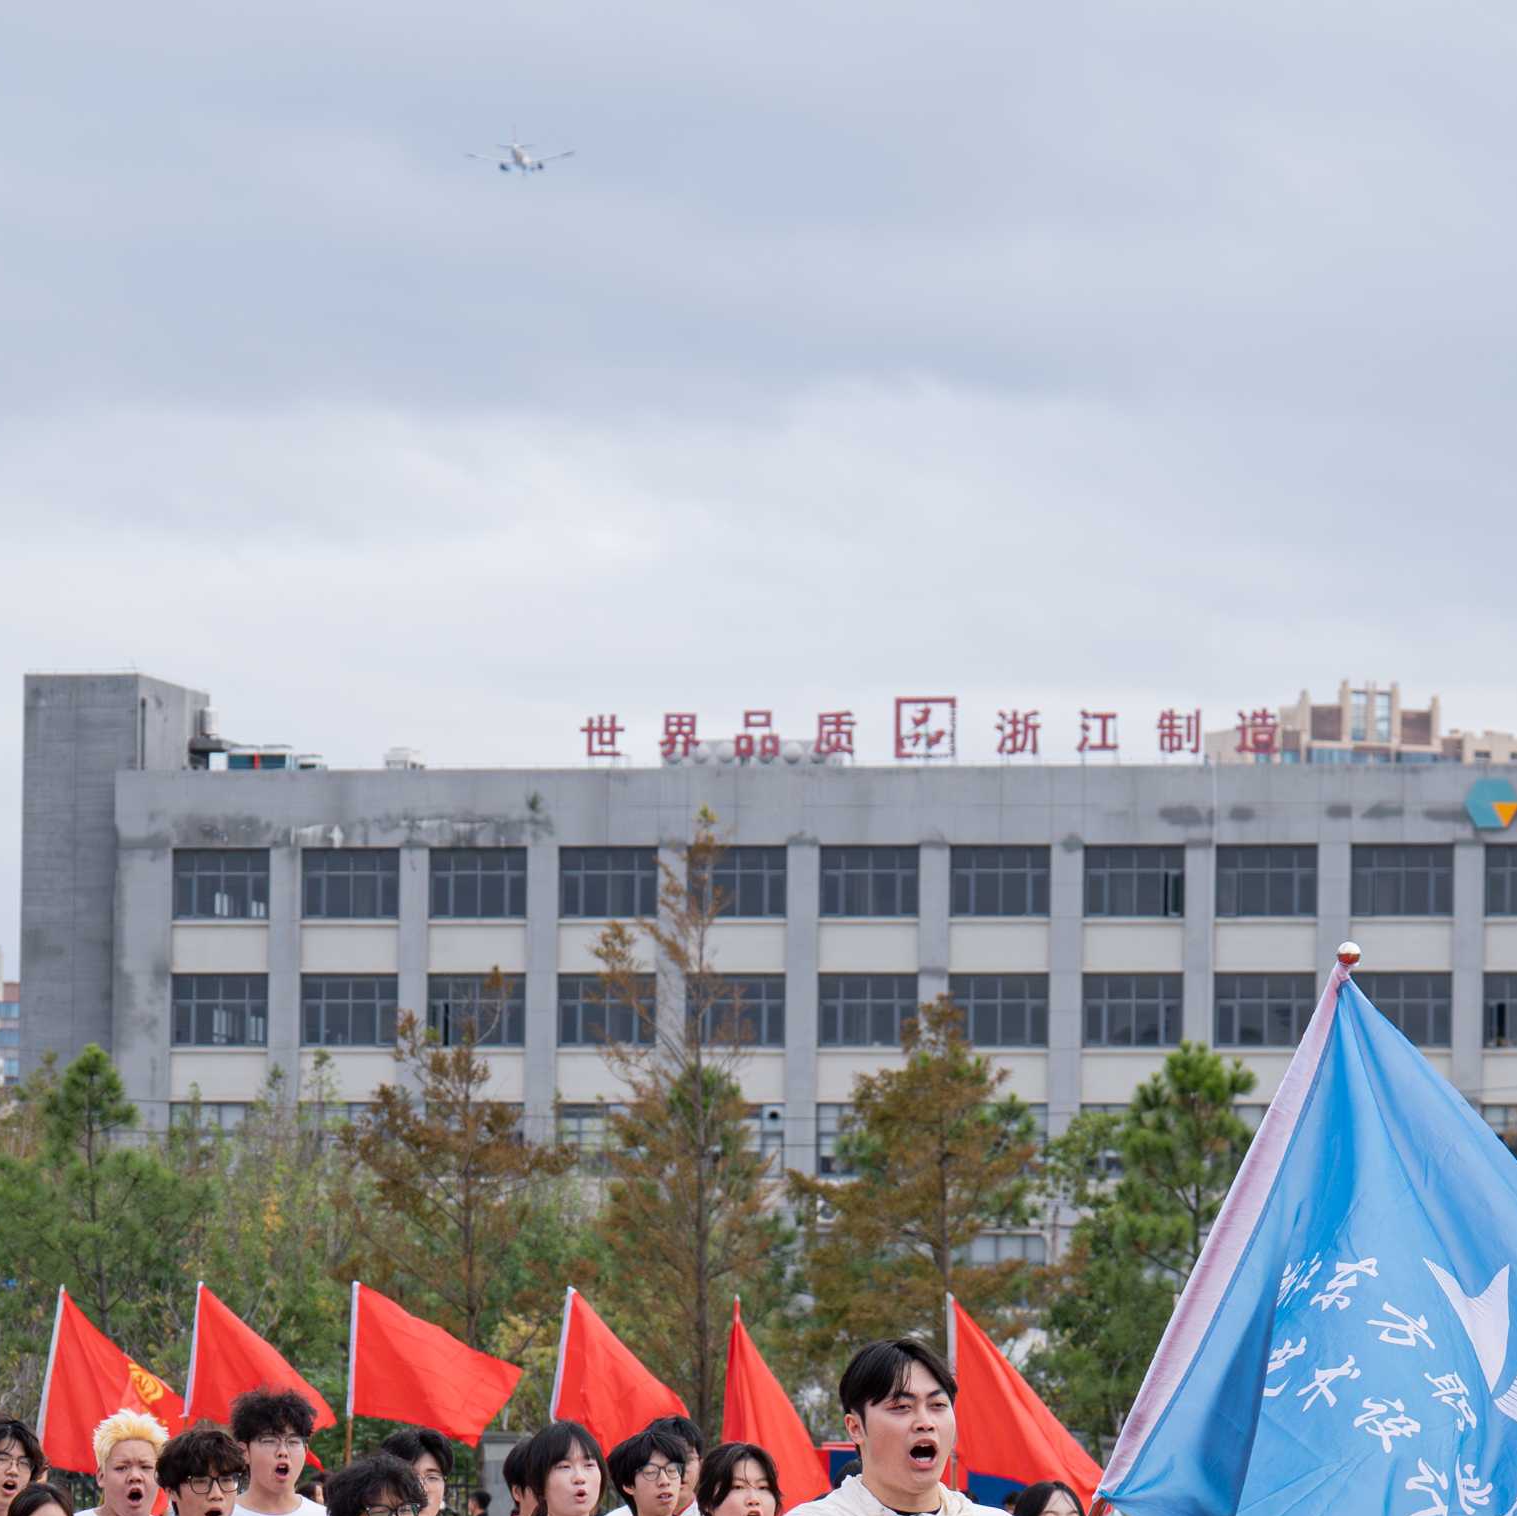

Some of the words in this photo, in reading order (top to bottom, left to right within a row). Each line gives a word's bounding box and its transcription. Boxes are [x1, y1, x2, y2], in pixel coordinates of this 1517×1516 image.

[580, 710, 857, 758] 世界品质
[995, 708, 1282, 757] 浙江制造
